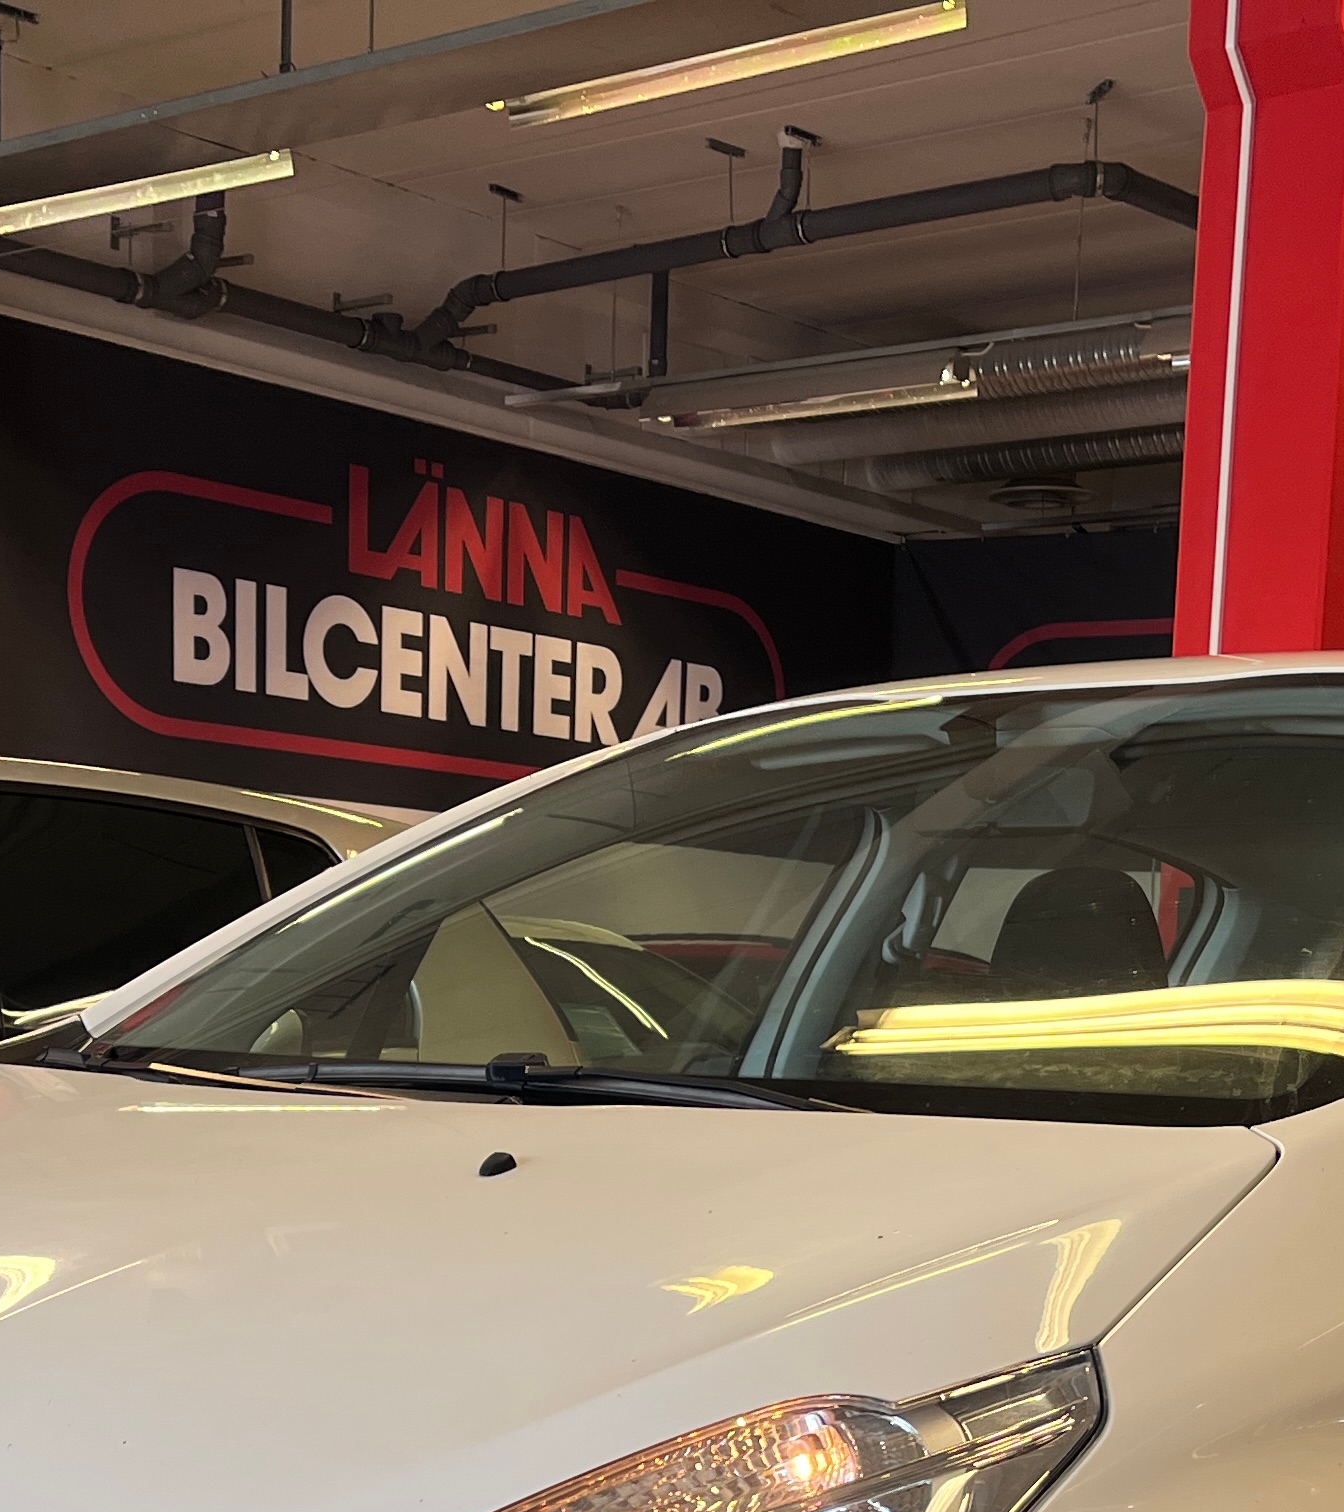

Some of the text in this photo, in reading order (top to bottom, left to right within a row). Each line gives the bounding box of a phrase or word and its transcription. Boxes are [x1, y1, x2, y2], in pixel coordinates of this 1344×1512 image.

[348, 458, 622, 626] LÄNNA
[172, 567, 723, 747] BILCENTER AB
